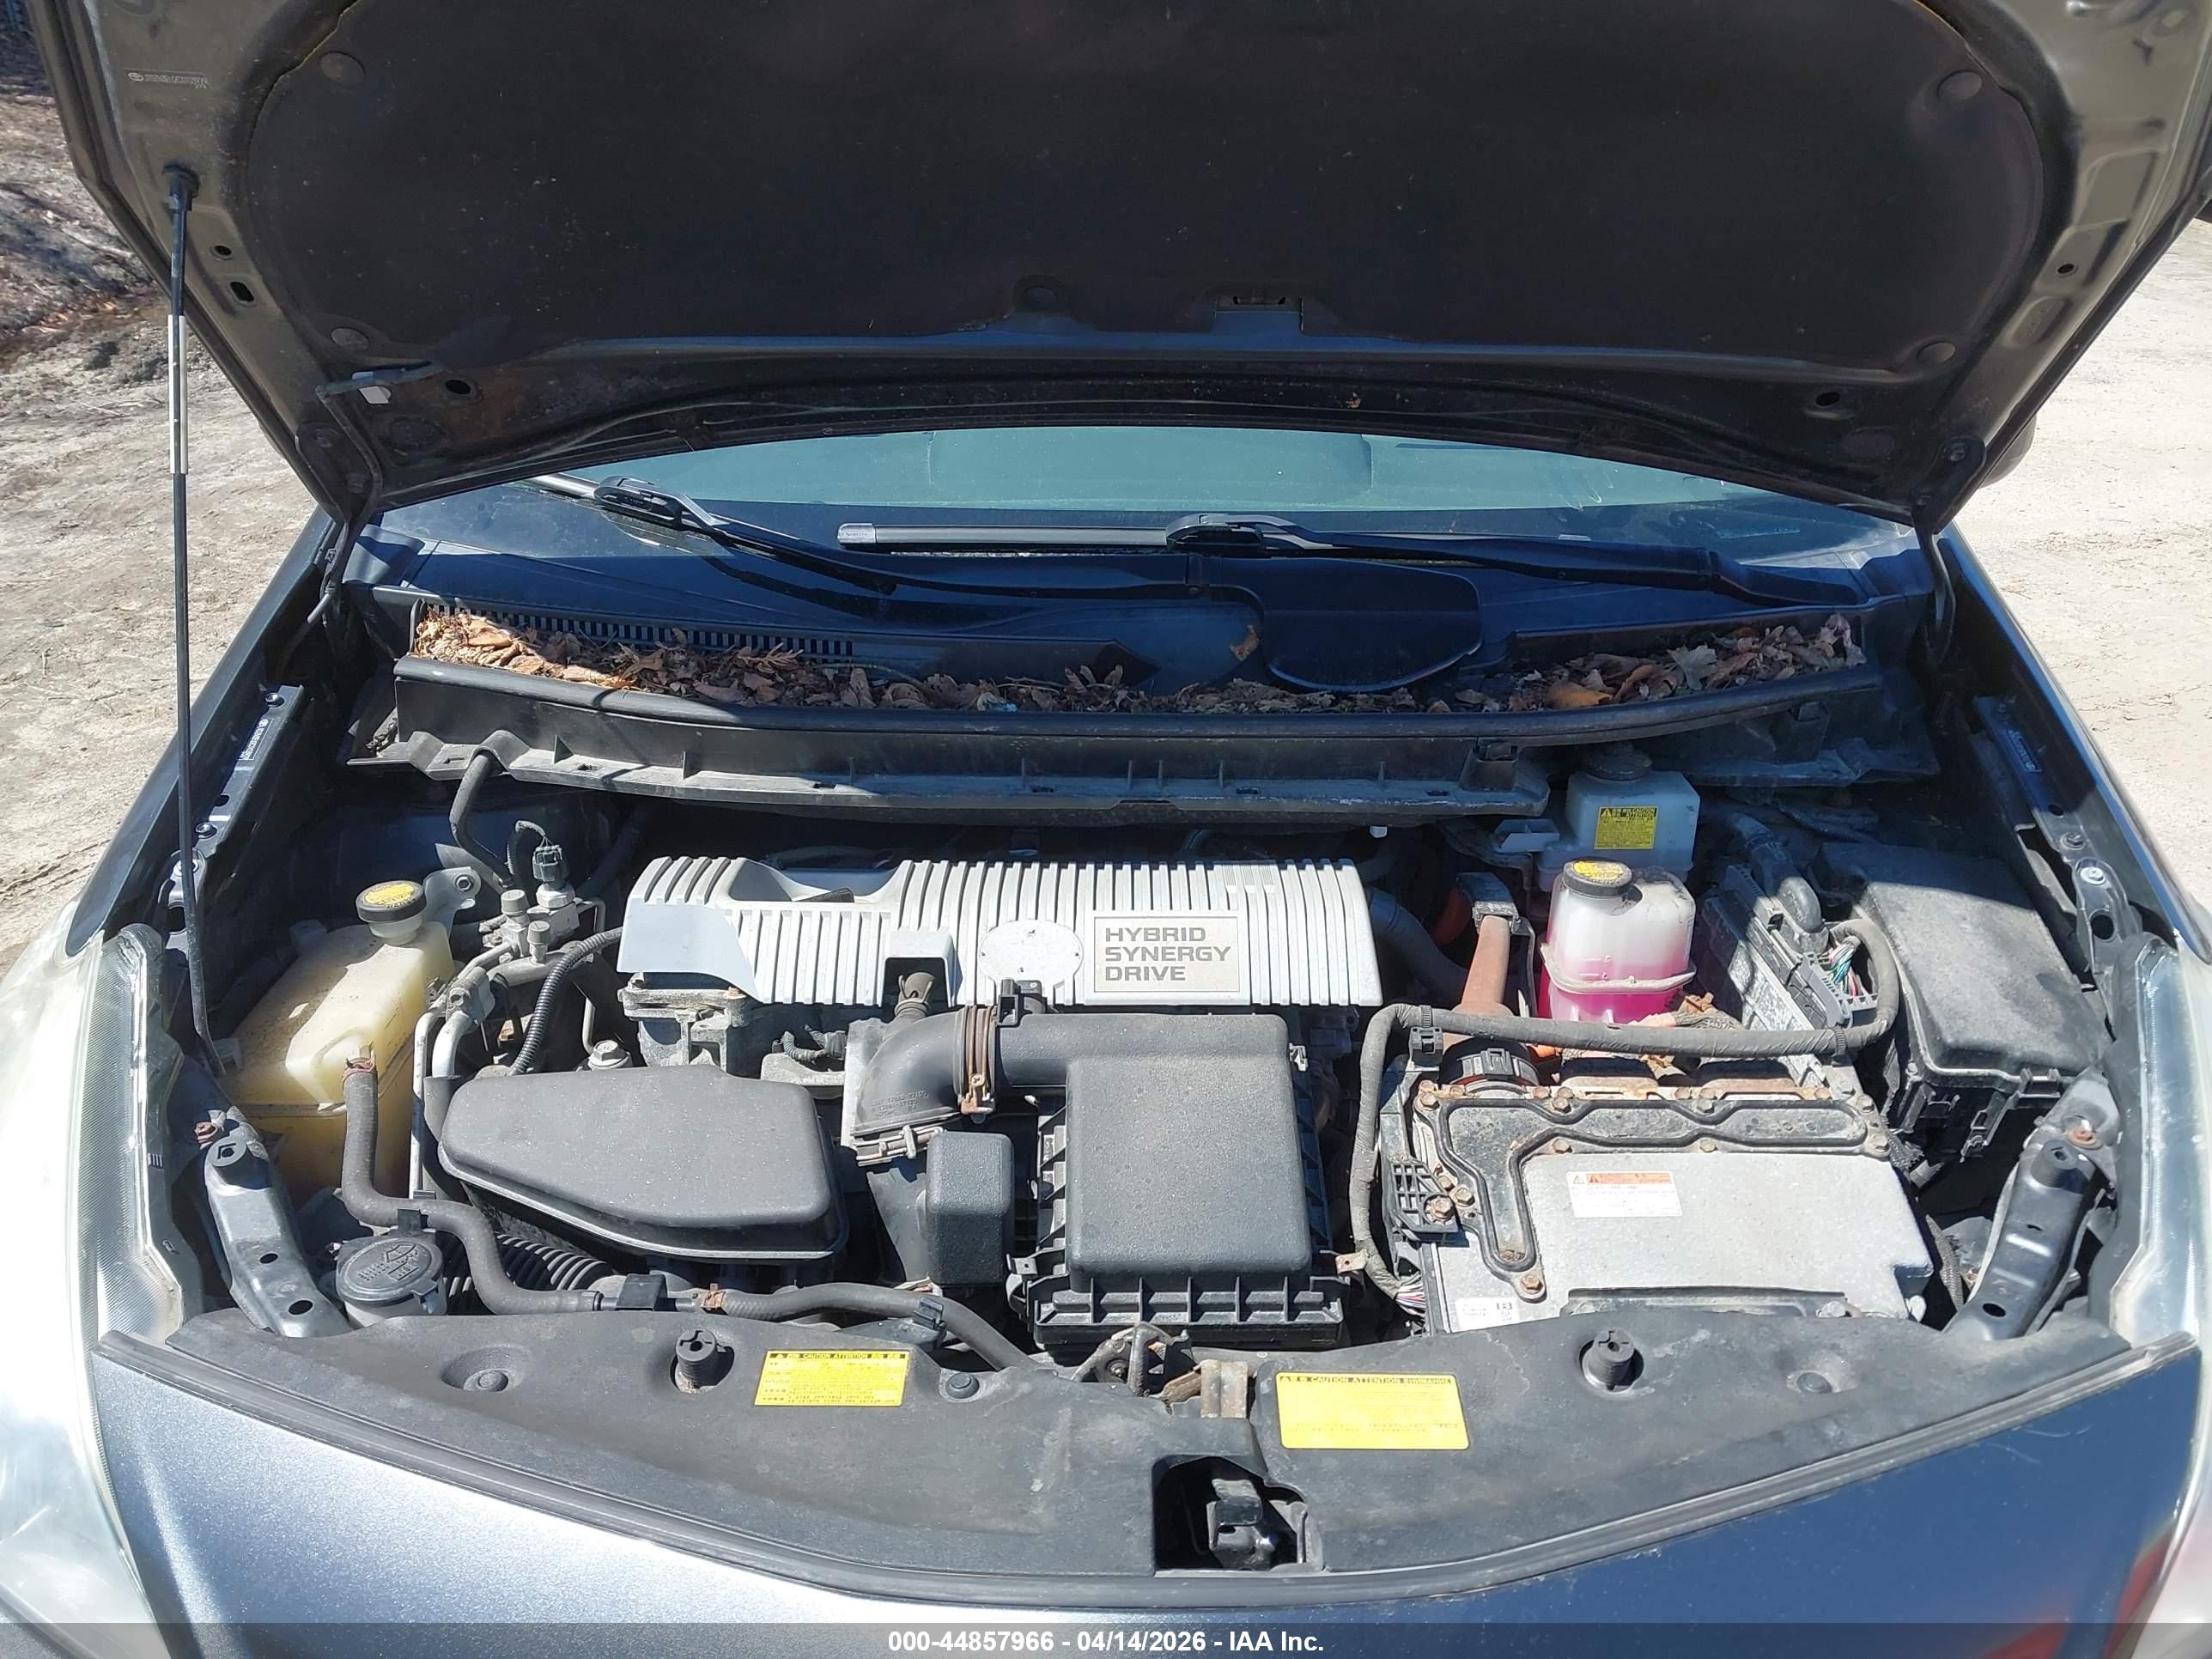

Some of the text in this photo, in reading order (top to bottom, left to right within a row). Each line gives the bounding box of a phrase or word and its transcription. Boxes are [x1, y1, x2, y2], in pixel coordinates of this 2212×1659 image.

[1105, 927, 1206, 942] HYBRID
[1105, 946, 1231, 962] SYNERGY
[1105, 966, 1186, 981] DRIVE
